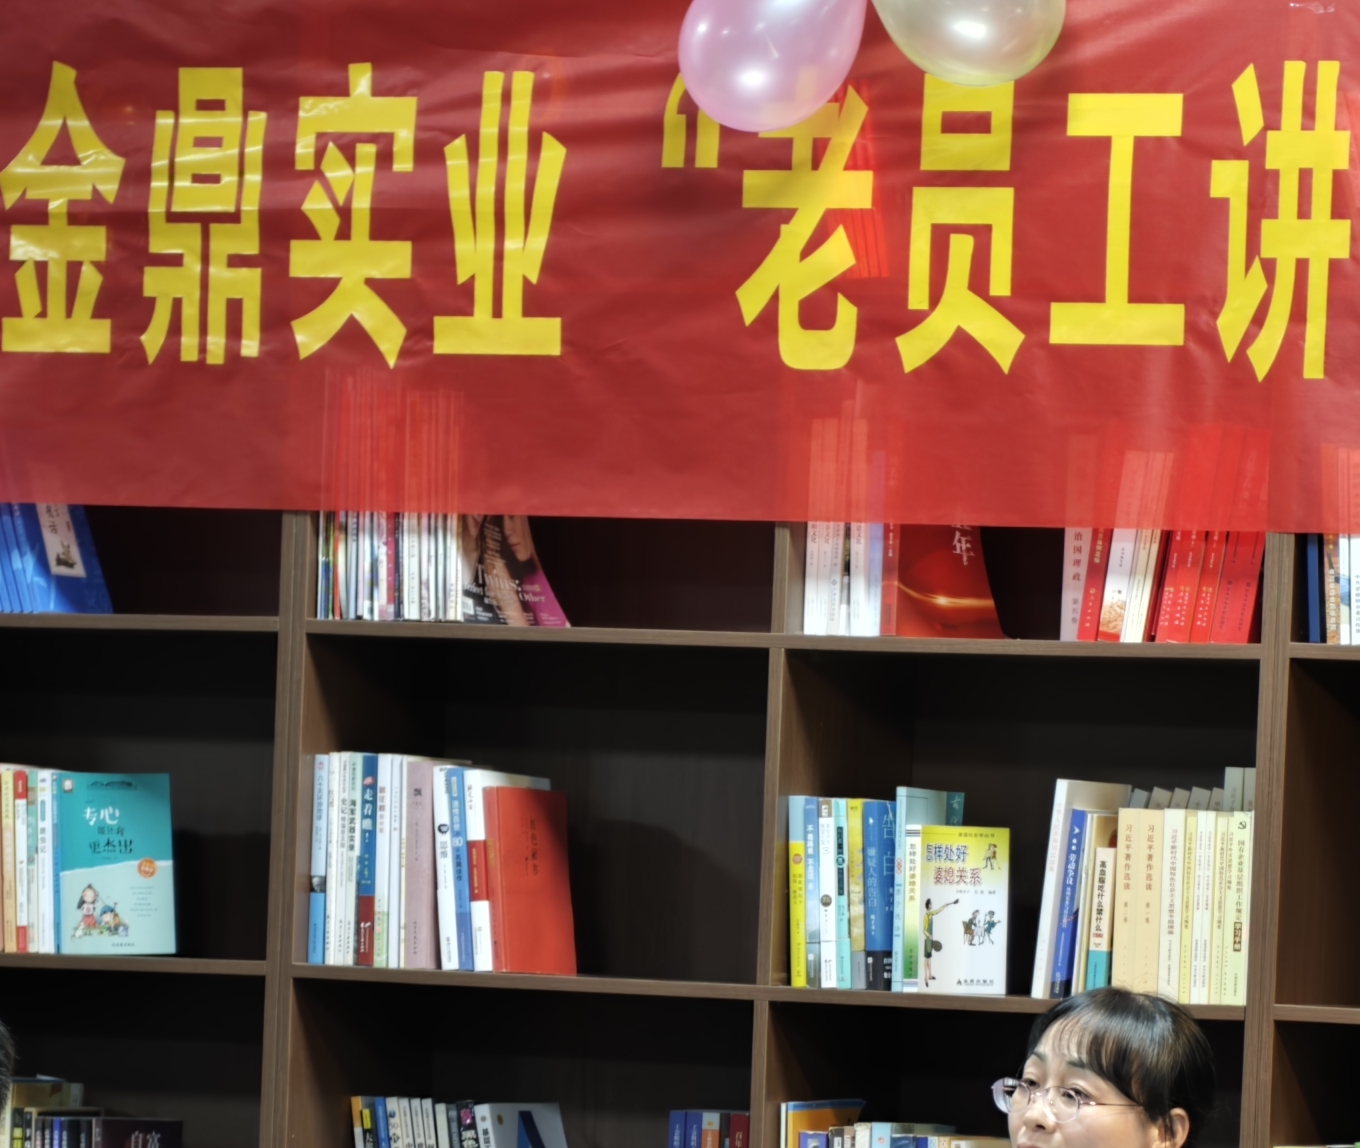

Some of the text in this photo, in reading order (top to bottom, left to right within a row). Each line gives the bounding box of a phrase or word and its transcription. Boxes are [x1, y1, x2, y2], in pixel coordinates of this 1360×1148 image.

[82, 806, 120, 826] 专心
[89, 838, 133, 854] 更杰出
[925, 843, 969, 863] 怎样处好
[1123, 824, 1133, 891] 习近平著作选读
[1145, 824, 1155, 891] 习近平著作选读
[933, 866, 982, 886] 婆媳关系
[1095, 860, 1107, 932] 高血脂吃什么禁什么
